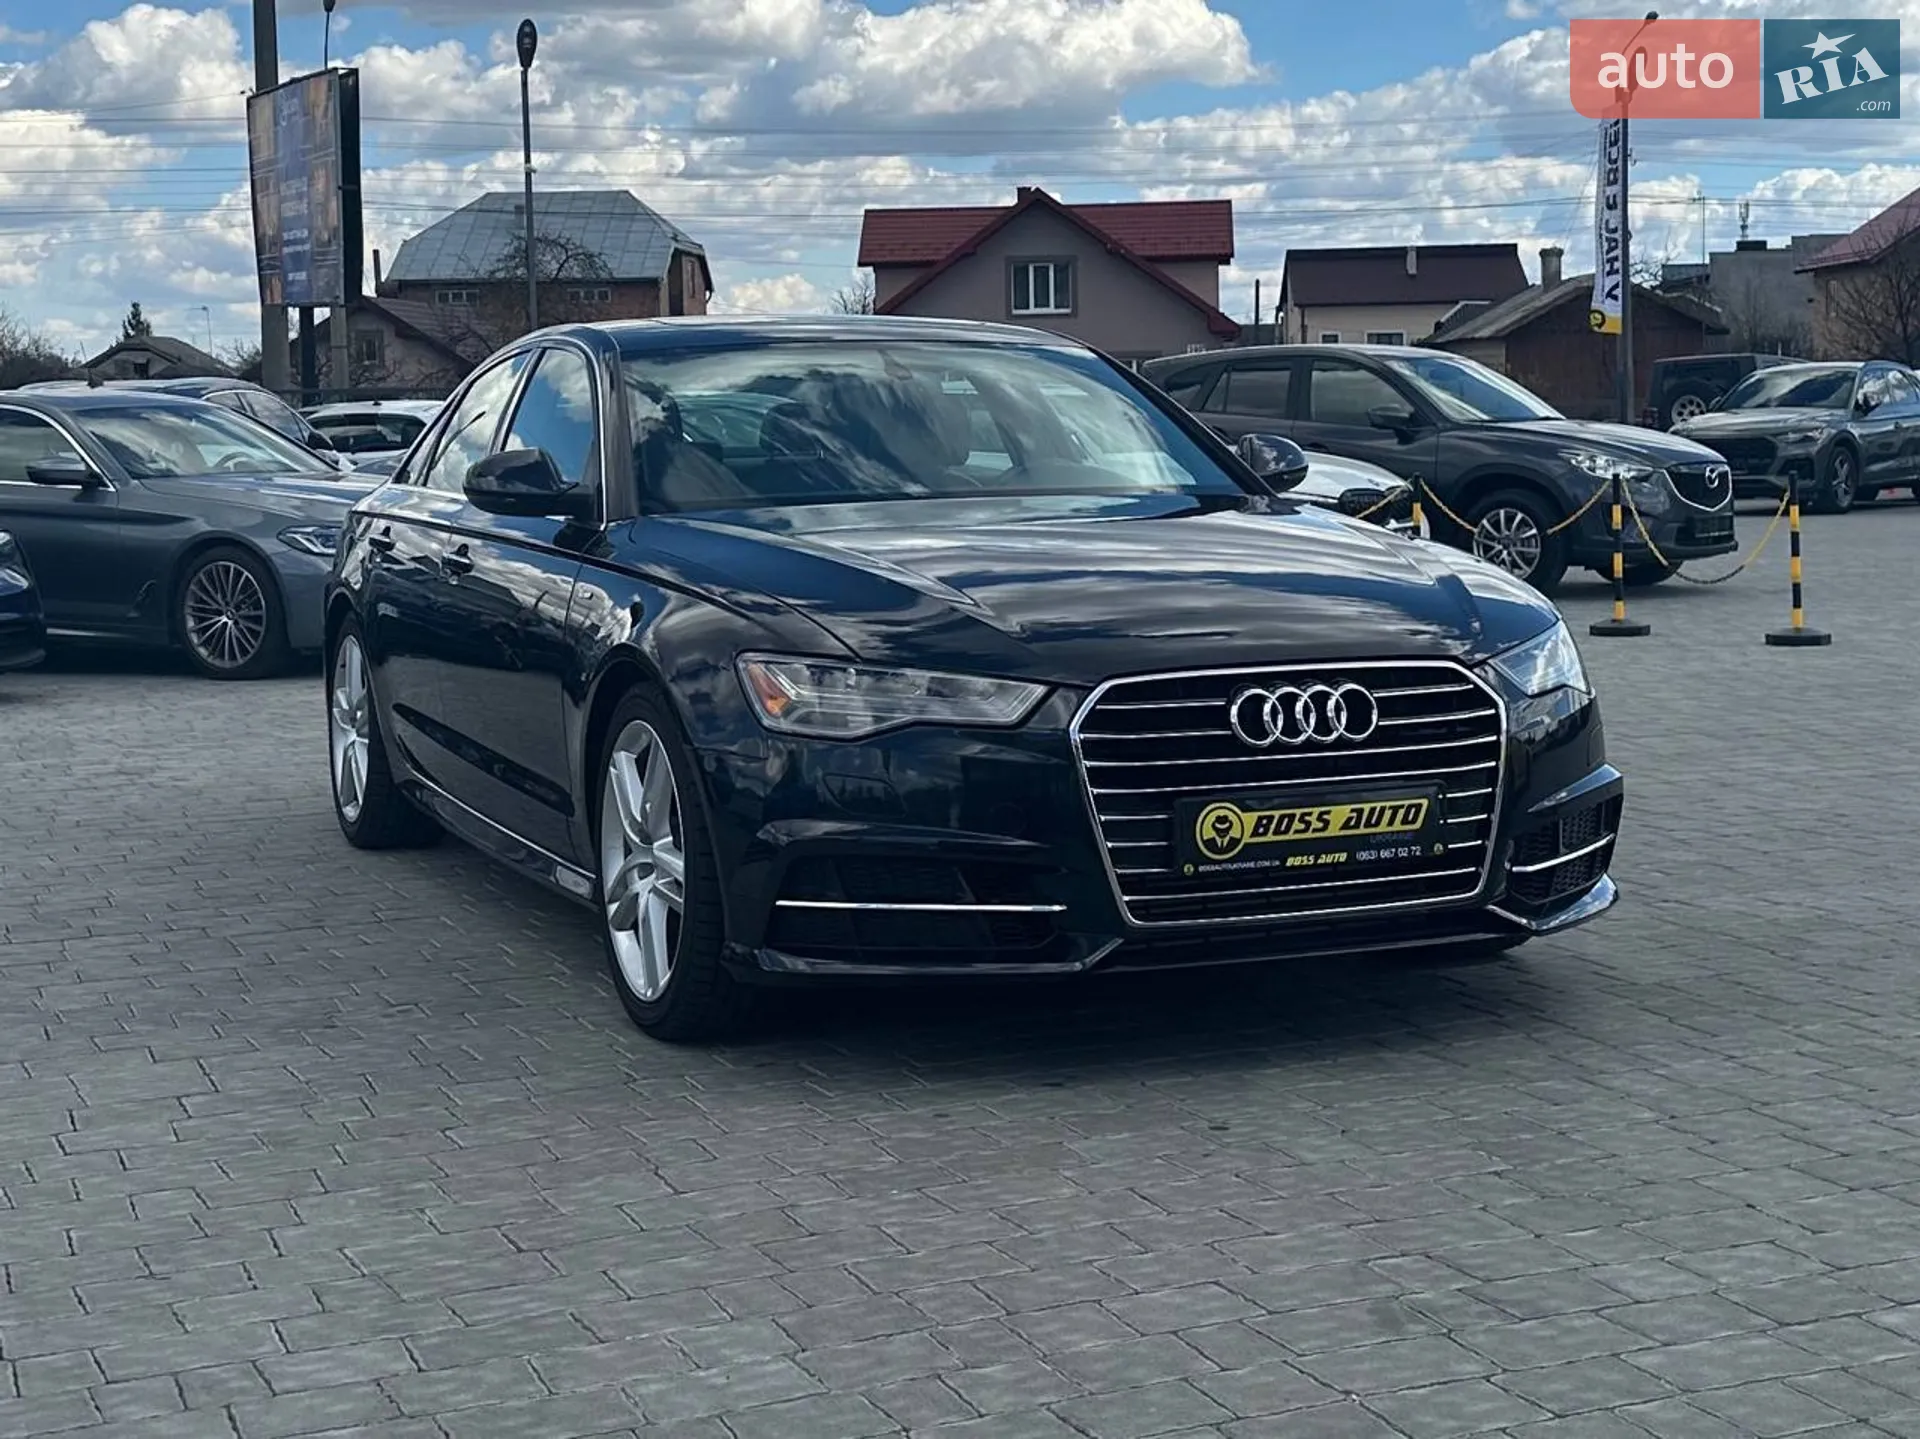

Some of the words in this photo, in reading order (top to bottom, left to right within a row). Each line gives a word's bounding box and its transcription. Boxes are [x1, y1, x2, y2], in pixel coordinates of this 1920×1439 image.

[1250, 810, 1332, 838] BOSS
[1339, 803, 1423, 831] AUTO
[1397, 847, 1408, 857] 02
[1410, 845, 1421, 856] 72
[1285, 855, 1315, 866] BOSS
[1317, 852, 1347, 864] AUTO
